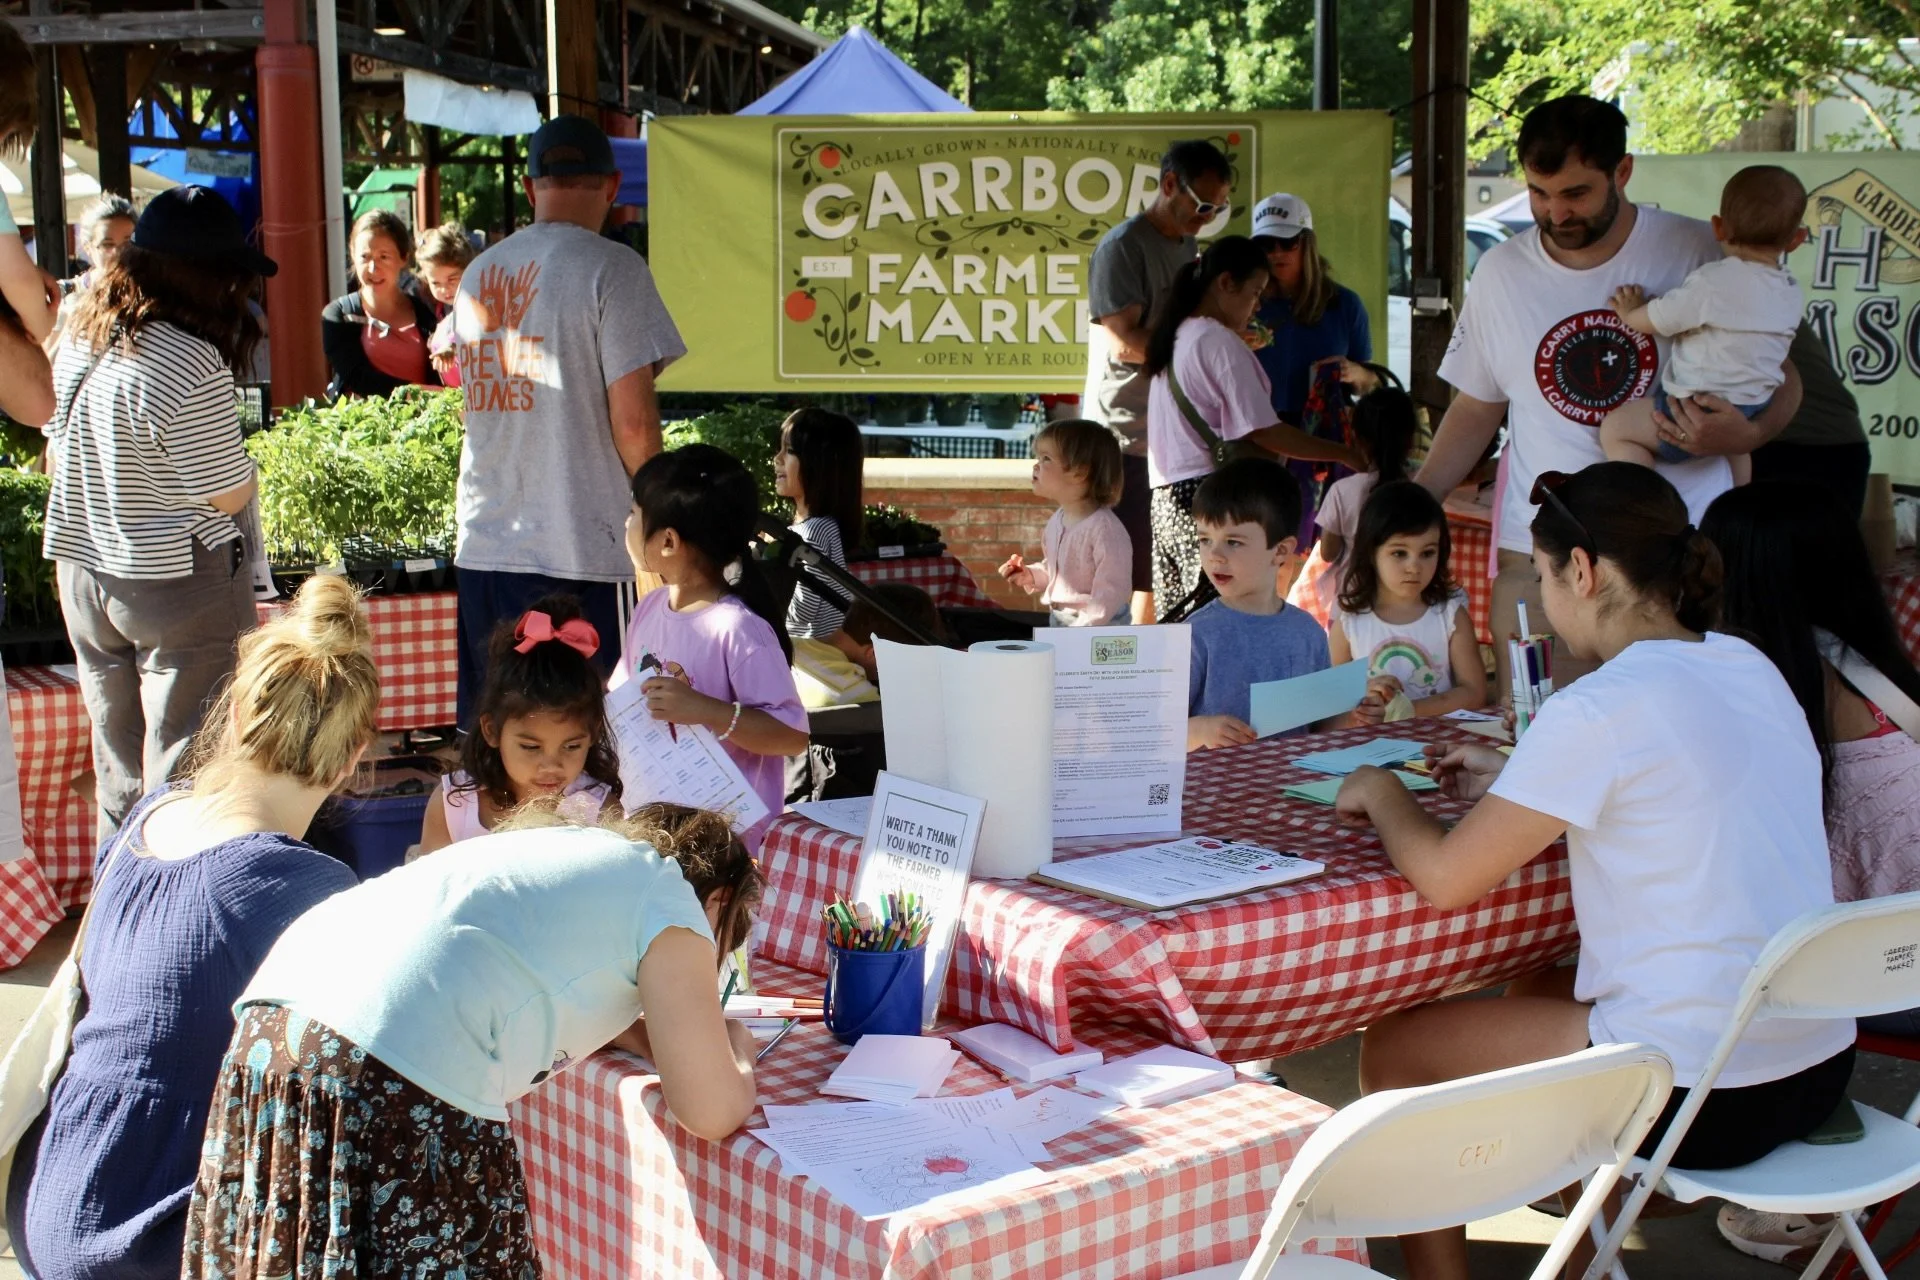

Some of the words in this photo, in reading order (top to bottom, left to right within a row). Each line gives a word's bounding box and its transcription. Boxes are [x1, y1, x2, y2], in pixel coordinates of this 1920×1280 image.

[840, 146, 915, 175] LOCALLY
[923, 138, 987, 157] GROWN
[1007, 136, 1120, 154] NATIONALLY
[812, 261, 842, 273] EST.
[1541, 319, 1578, 359] CARRY
[1592, 329, 1626, 344] RIVER
[924, 352, 974, 367] OPEN
[984, 352, 1032, 367] YEAR
[1547, 391, 1593, 420] CARRY
[886, 815, 916, 836] WRITE
[916, 824, 924, 838] A
[927, 827, 959, 849] THANK
[886, 833, 906, 852] YOU
[906, 840, 932, 860] NOTE
[935, 848, 950, 865] TO
[886, 852, 905, 868] THE
[905, 858, 942, 881] FARMER
[1883, 943, 1918, 956] CARRBORO
[1883, 959, 1916, 974] MARKET
[1458, 1138, 1503, 1167] CFM
